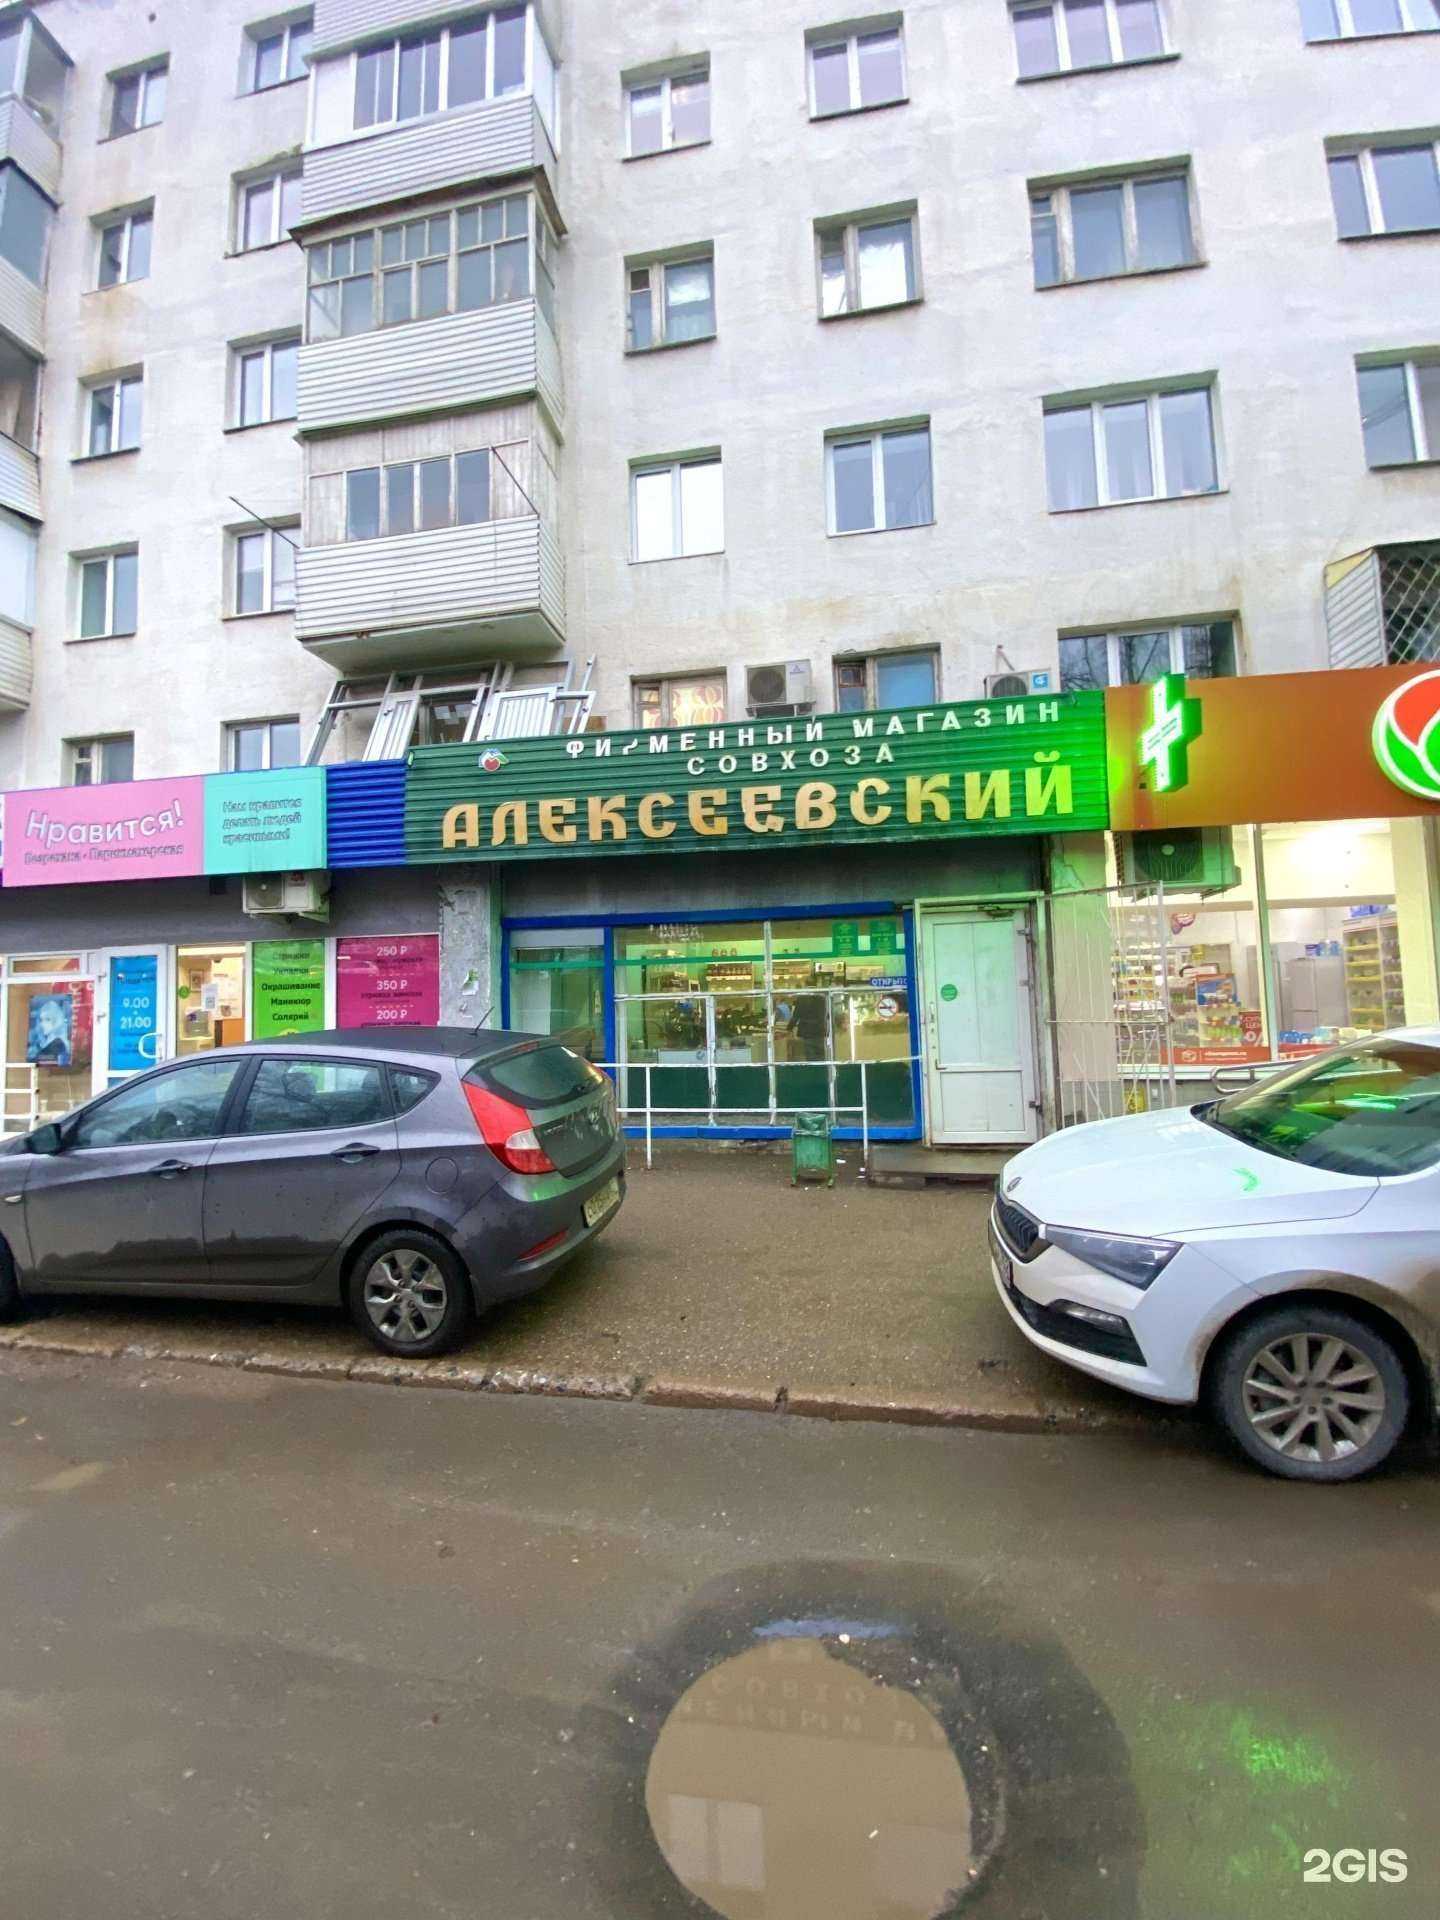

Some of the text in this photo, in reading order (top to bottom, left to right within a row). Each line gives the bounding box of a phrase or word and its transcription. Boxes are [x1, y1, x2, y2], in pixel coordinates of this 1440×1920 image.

[853, 702, 1059, 738] МАГАЗИН
[687, 742, 895, 776] СОВХОЗА
[442, 750, 1074, 849] АЛЕКСЕЕВСКИЙ
[25, 799, 184, 848] Нравится!
[376, 946, 397, 956] 250
[261, 982, 320, 992] Окрашивание
[376, 980, 397, 990] 350
[122, 997, 149, 1009] 9.00
[271, 998, 311, 1007] Маникюр
[272, 1012, 309, 1021] Солярий
[376, 1009, 398, 1020] 200
[120, 1017, 151, 1029] 21.00
